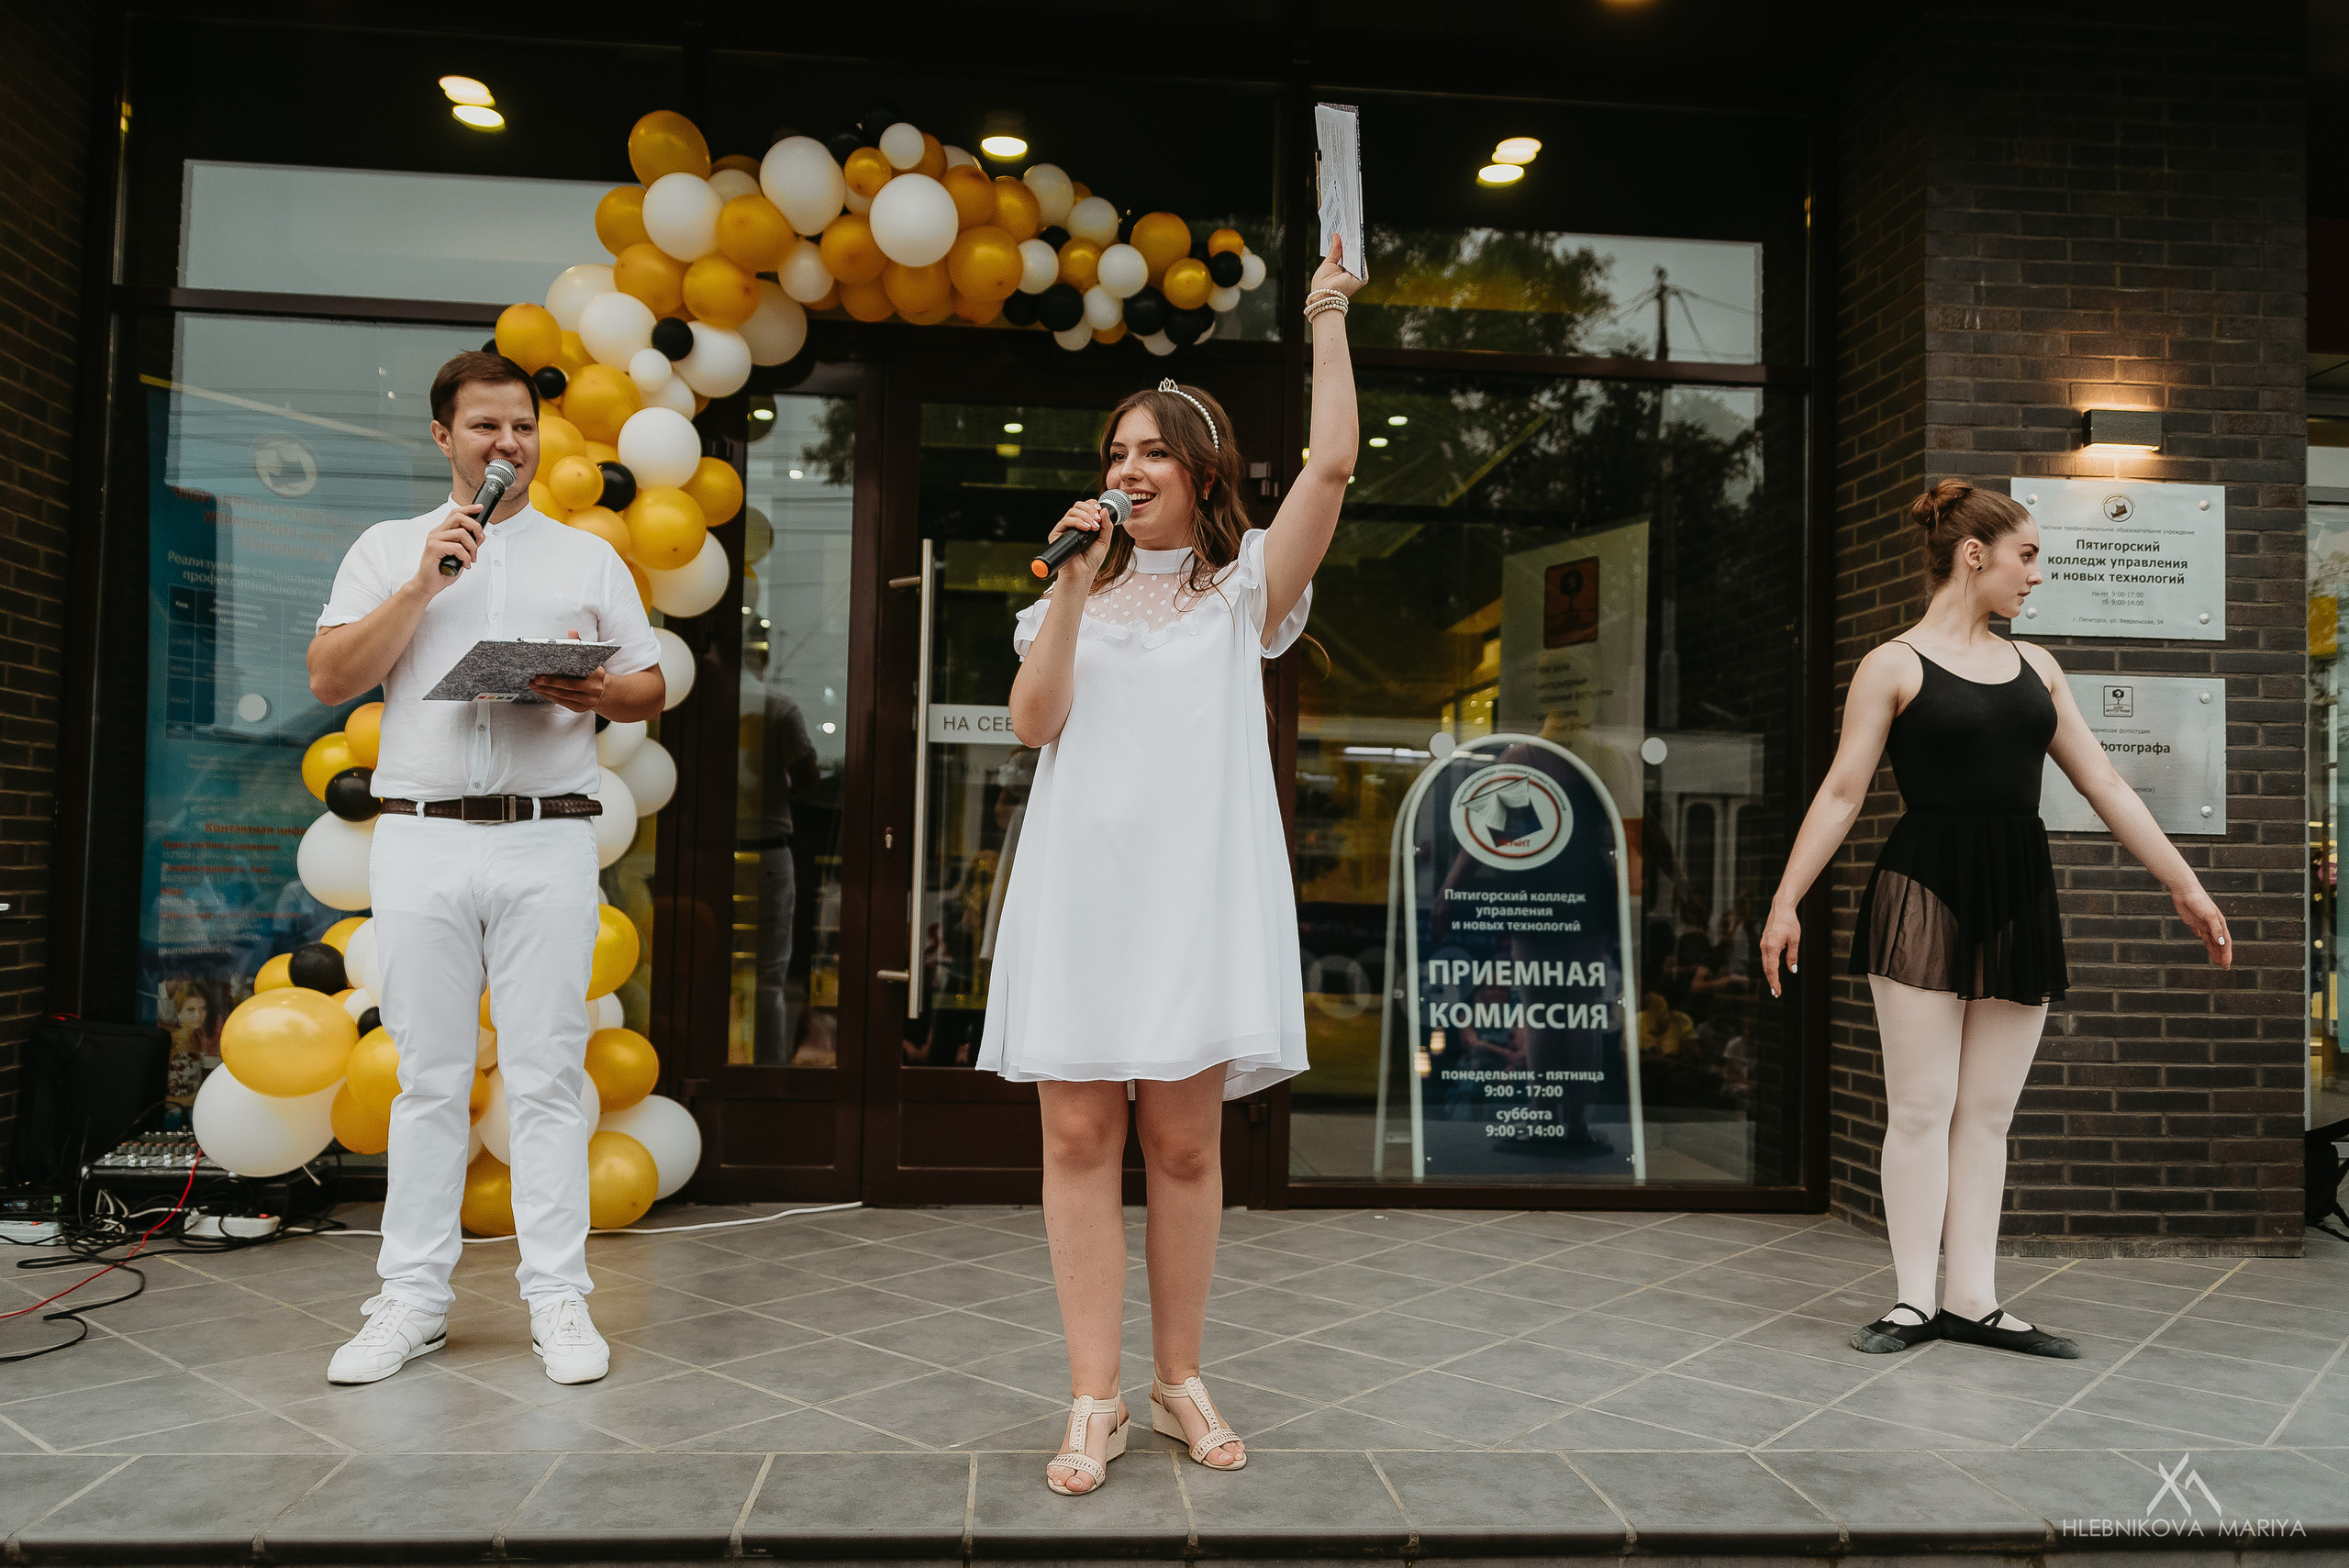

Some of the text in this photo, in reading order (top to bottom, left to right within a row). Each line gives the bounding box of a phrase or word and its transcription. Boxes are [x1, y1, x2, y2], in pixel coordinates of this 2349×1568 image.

[2076, 539, 2160, 553] Пятигорский
[168, 550, 334, 586] Реализуемые специальност
[2047, 556, 2188, 569] колледж управления
[2051, 572, 2185, 584] и новых технологий
[943, 716, 1015, 731] НА СЕБ
[276, 827, 307, 838] инфо
[1444, 889, 1586, 904] Пятигорский колледж
[1475, 906, 1553, 918] управления
[1452, 920, 1581, 932] и новых технологий
[1429, 960, 1606, 987] ПРИЕМНАЯ
[1430, 1002, 1609, 1029] КОМИССИЯ
[1442, 1070, 1535, 1082] понедельник
[1546, 1071, 1605, 1083] пятница
[1484, 1085, 1513, 1097] 9:00
[1525, 1085, 1563, 1097] 17:00
[1496, 1107, 1553, 1122] суббота
[1486, 1125, 1516, 1137] 9:00
[1528, 1125, 1564, 1137] 14:00
